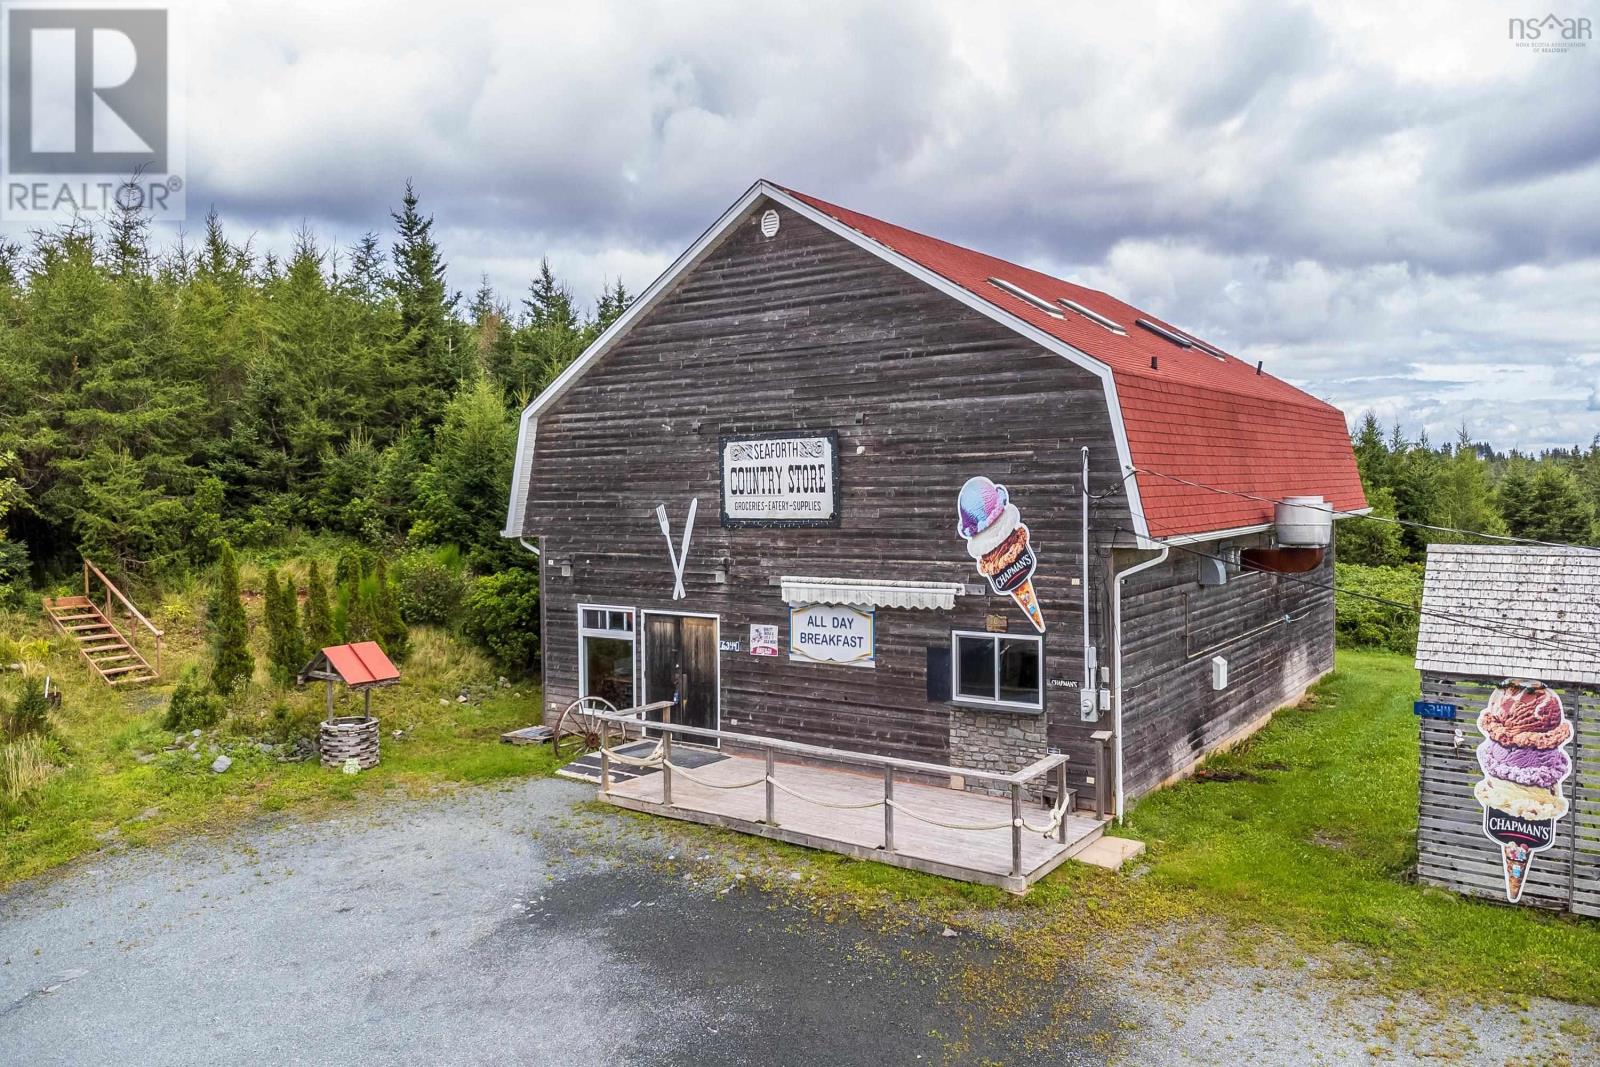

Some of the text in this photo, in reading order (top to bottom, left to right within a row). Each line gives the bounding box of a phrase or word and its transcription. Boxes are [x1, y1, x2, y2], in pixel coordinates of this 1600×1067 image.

[754, 441, 799, 460] SEAFORTH
[730, 464, 826, 495] COUNTRY STORE
[995, 554, 1032, 589] CHAPMAN'S
[807, 615, 854, 629] ALL DAY
[800, 632, 864, 649] BREAKFAST
[1489, 817, 1550, 840] CHAPMAN'S
